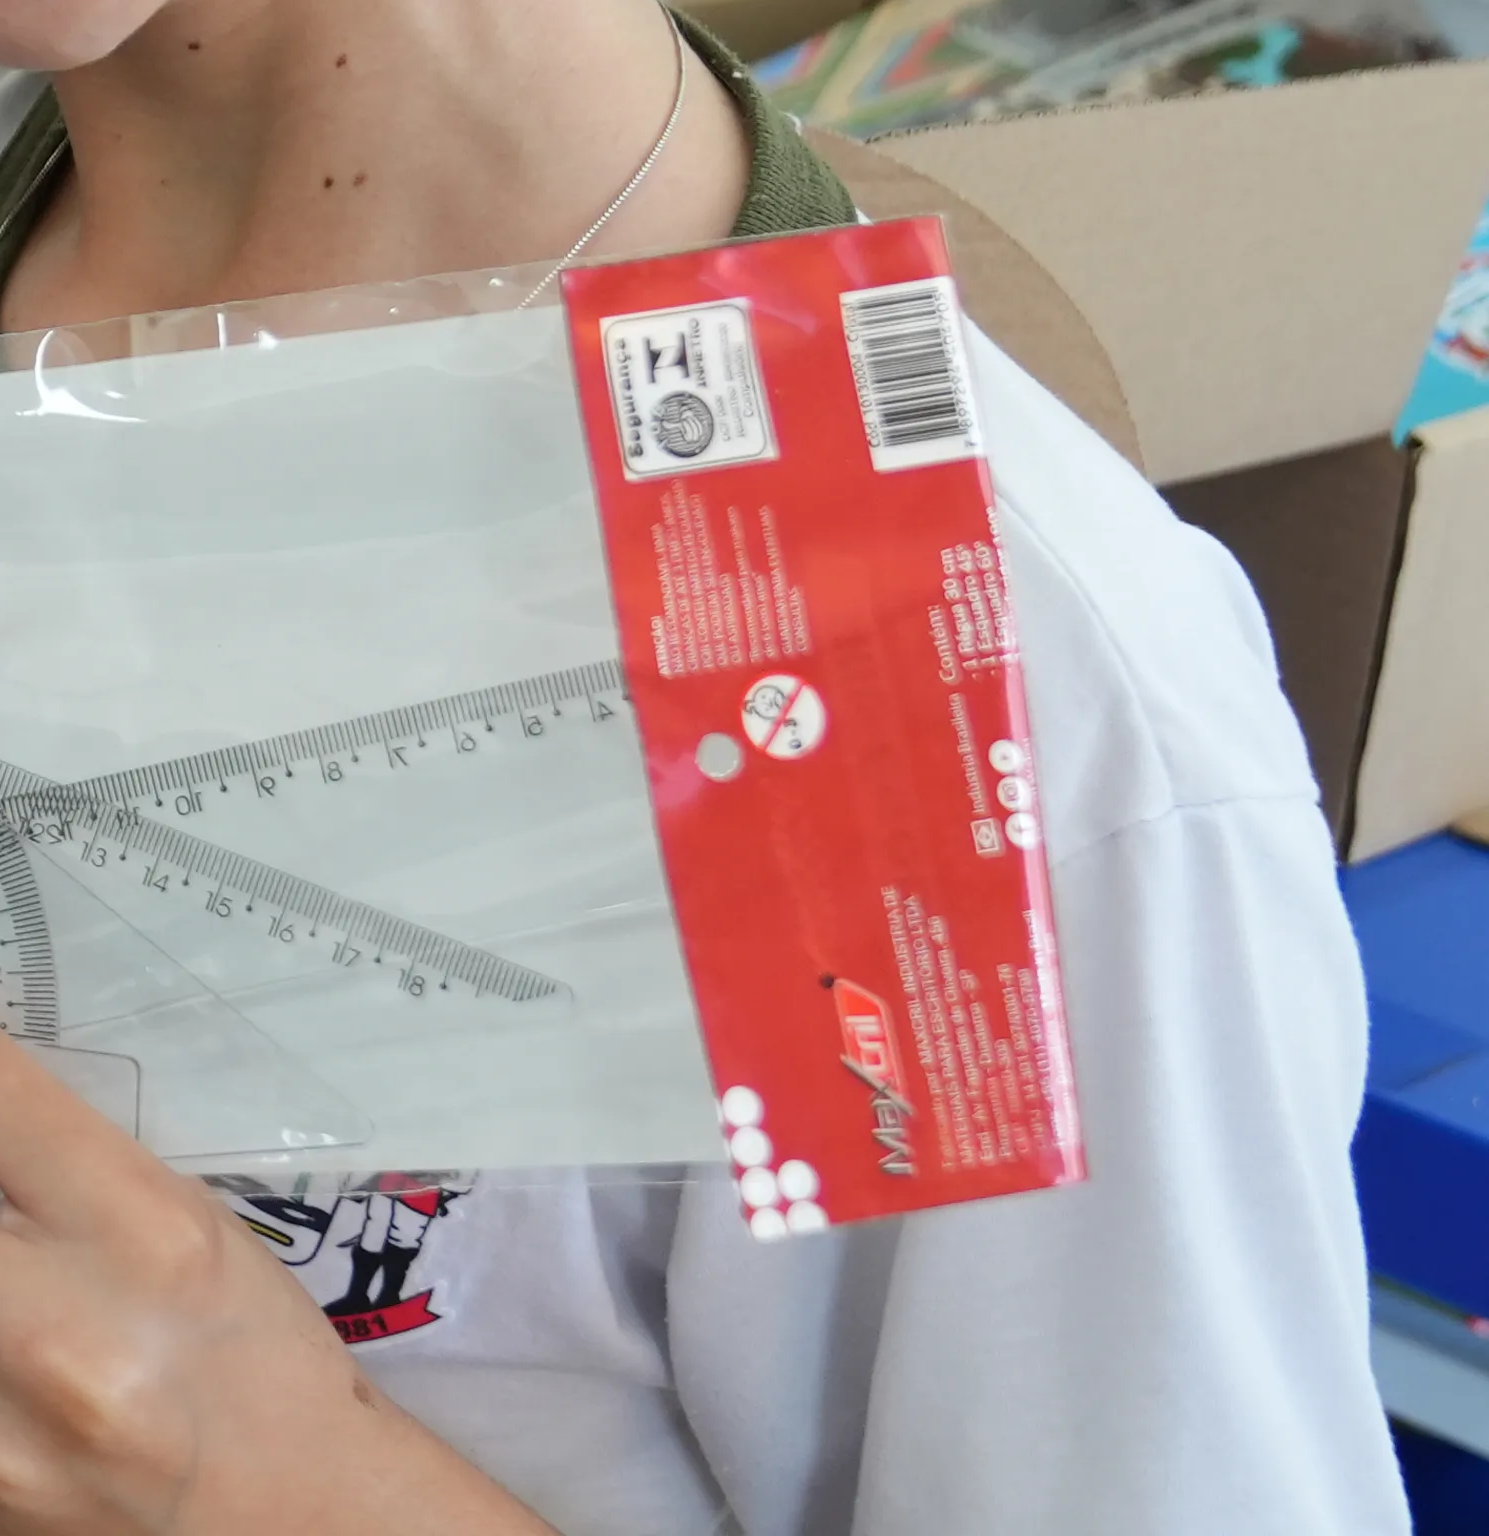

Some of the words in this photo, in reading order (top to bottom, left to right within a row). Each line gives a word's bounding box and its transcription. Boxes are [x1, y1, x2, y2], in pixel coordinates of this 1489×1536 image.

[687, 317, 707, 388] INMETRO
[616, 338, 645, 457] Segurança
[938, 548, 956, 574] cm
[922, 603, 957, 682] Contém:
[948, 602, 976, 653] Régua
[961, 574, 994, 651] Esquadro
[979, 571, 1013, 646] Esquadro
[648, 615, 670, 676] ATENÇÃO!
